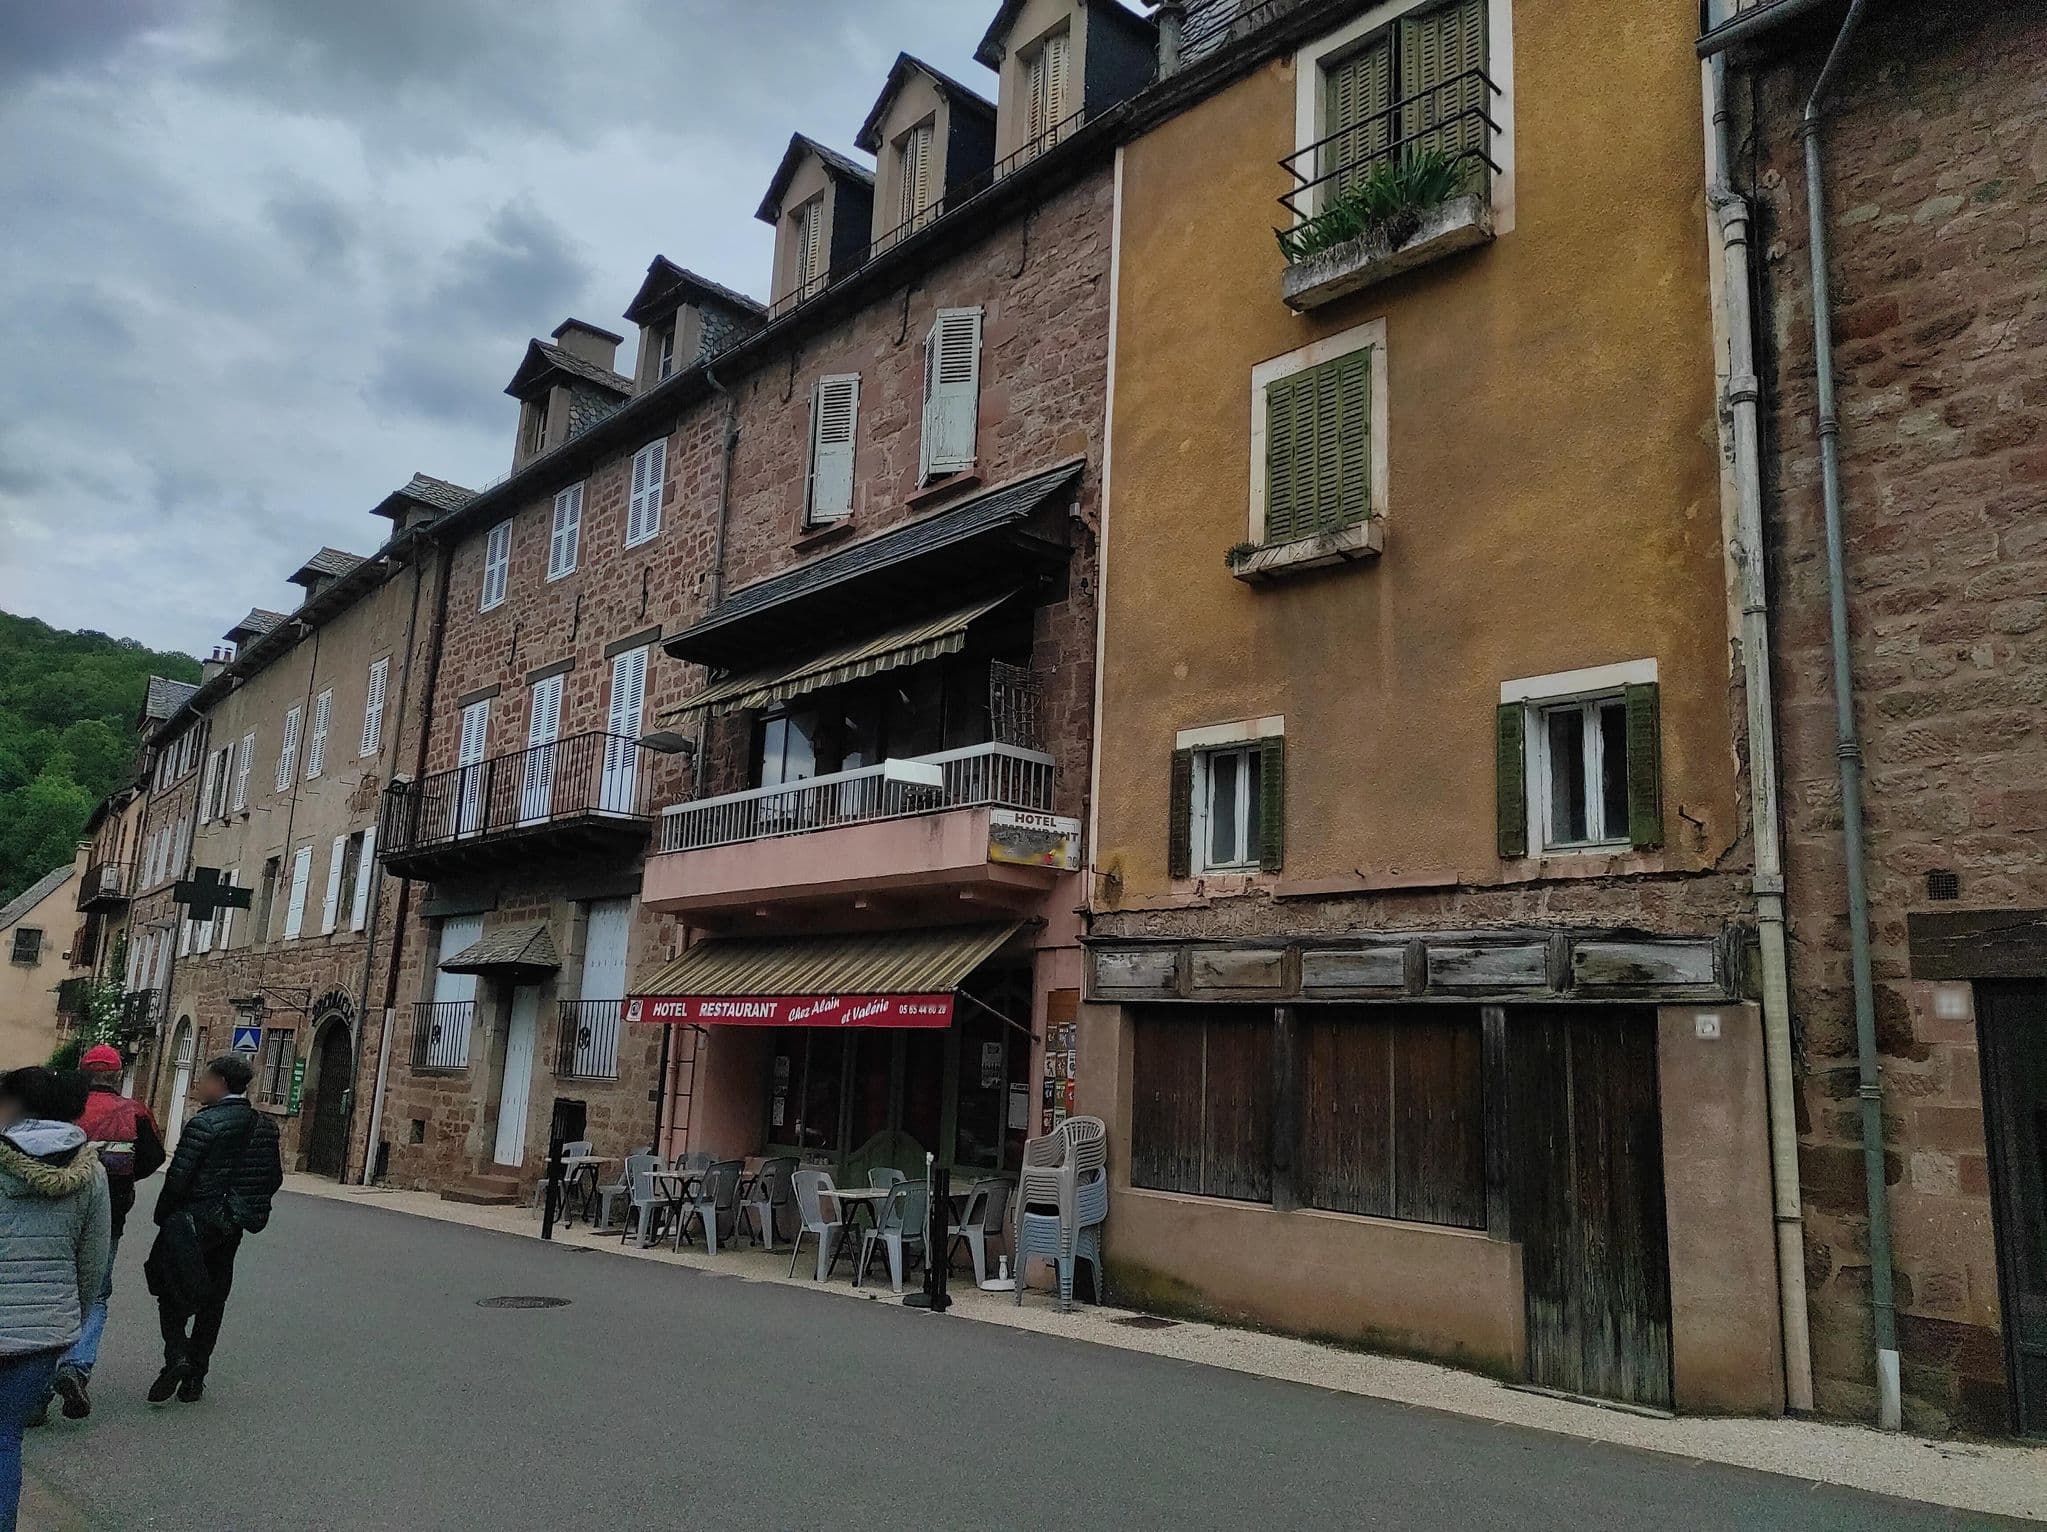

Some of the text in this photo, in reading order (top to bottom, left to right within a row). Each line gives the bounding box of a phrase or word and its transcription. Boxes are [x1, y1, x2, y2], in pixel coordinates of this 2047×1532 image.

[1015, 813, 1057, 827] HOTEL
[652, 1002, 777, 1017] HOTEL RESTAURANT
[788, 996, 840, 1022] Chez Alain
[841, 998, 890, 1024] et Valérie
[899, 1004, 908, 1015] 05
